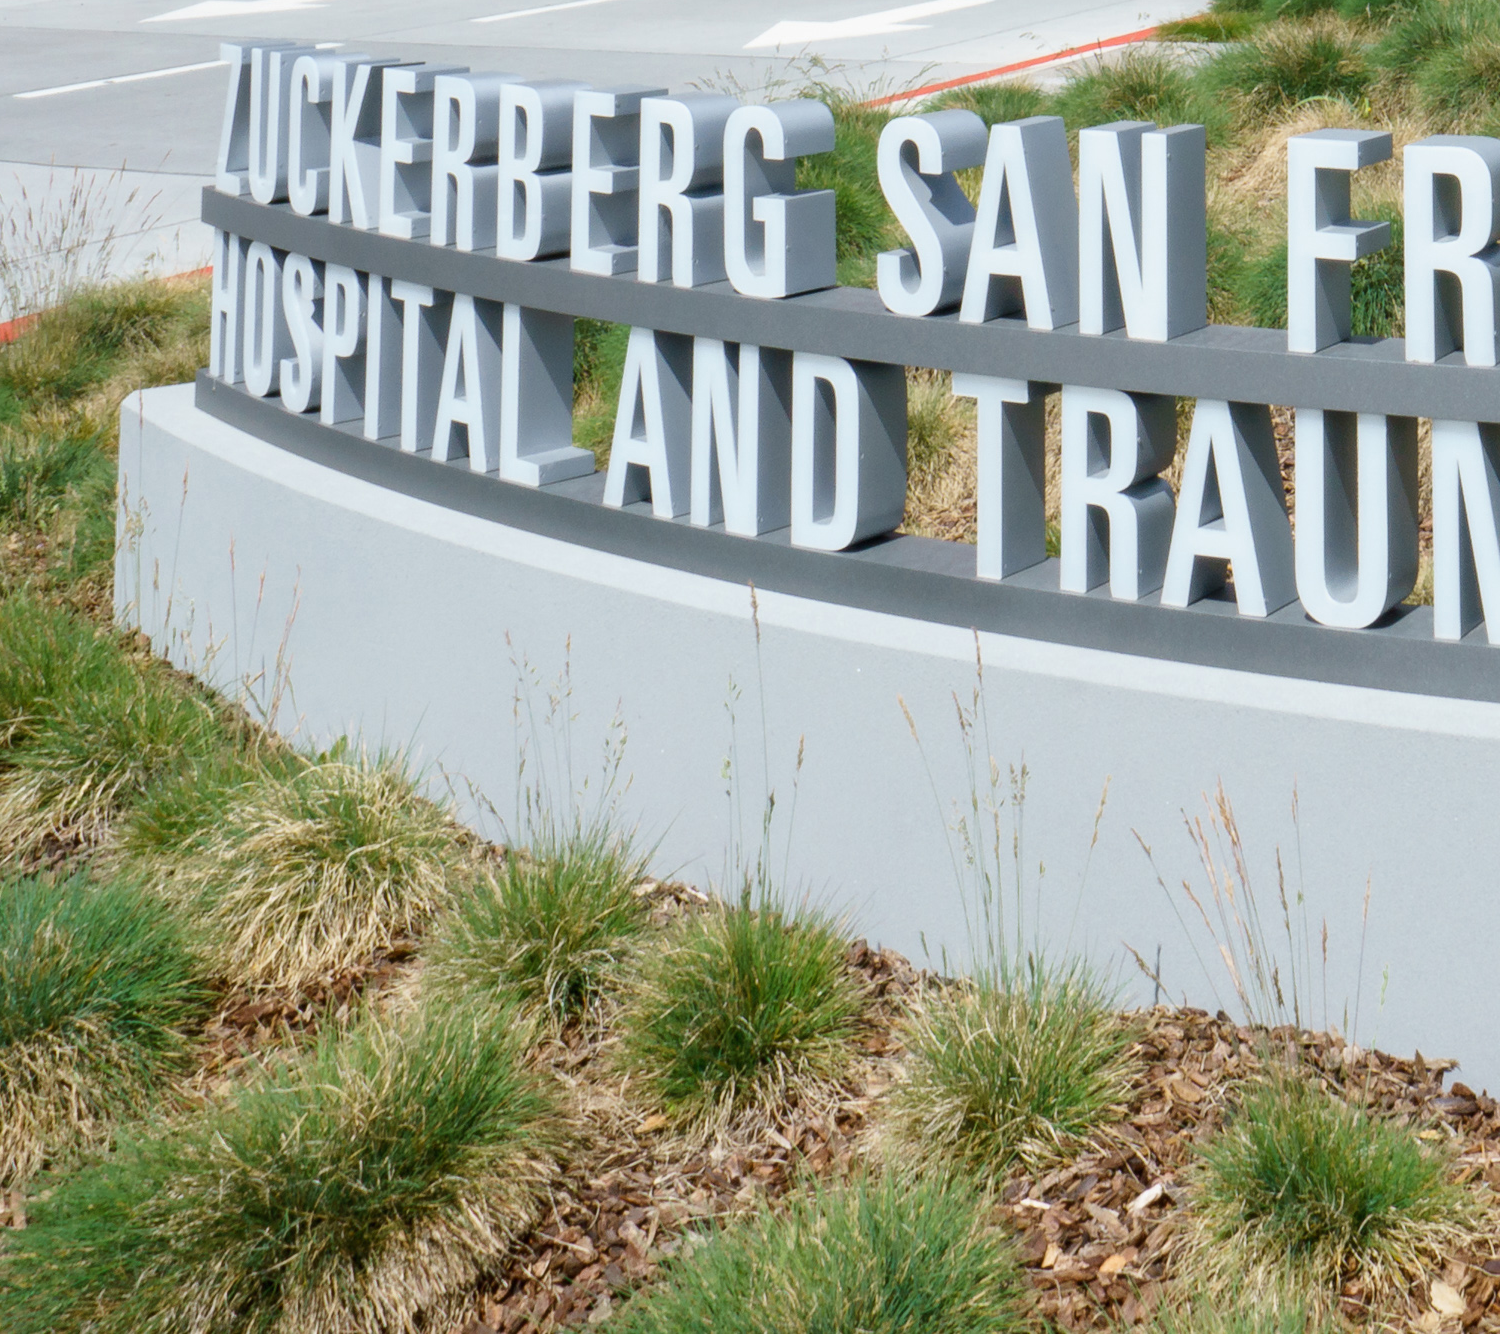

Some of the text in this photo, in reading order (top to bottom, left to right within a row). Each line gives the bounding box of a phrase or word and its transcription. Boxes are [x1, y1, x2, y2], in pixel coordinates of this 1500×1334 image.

[214, 40, 835, 298] ZUCKERBERG
[876, 110, 1206, 342] SAN
[209, 229, 595, 487] HOSPITAL
[603, 324, 900, 552] AND
